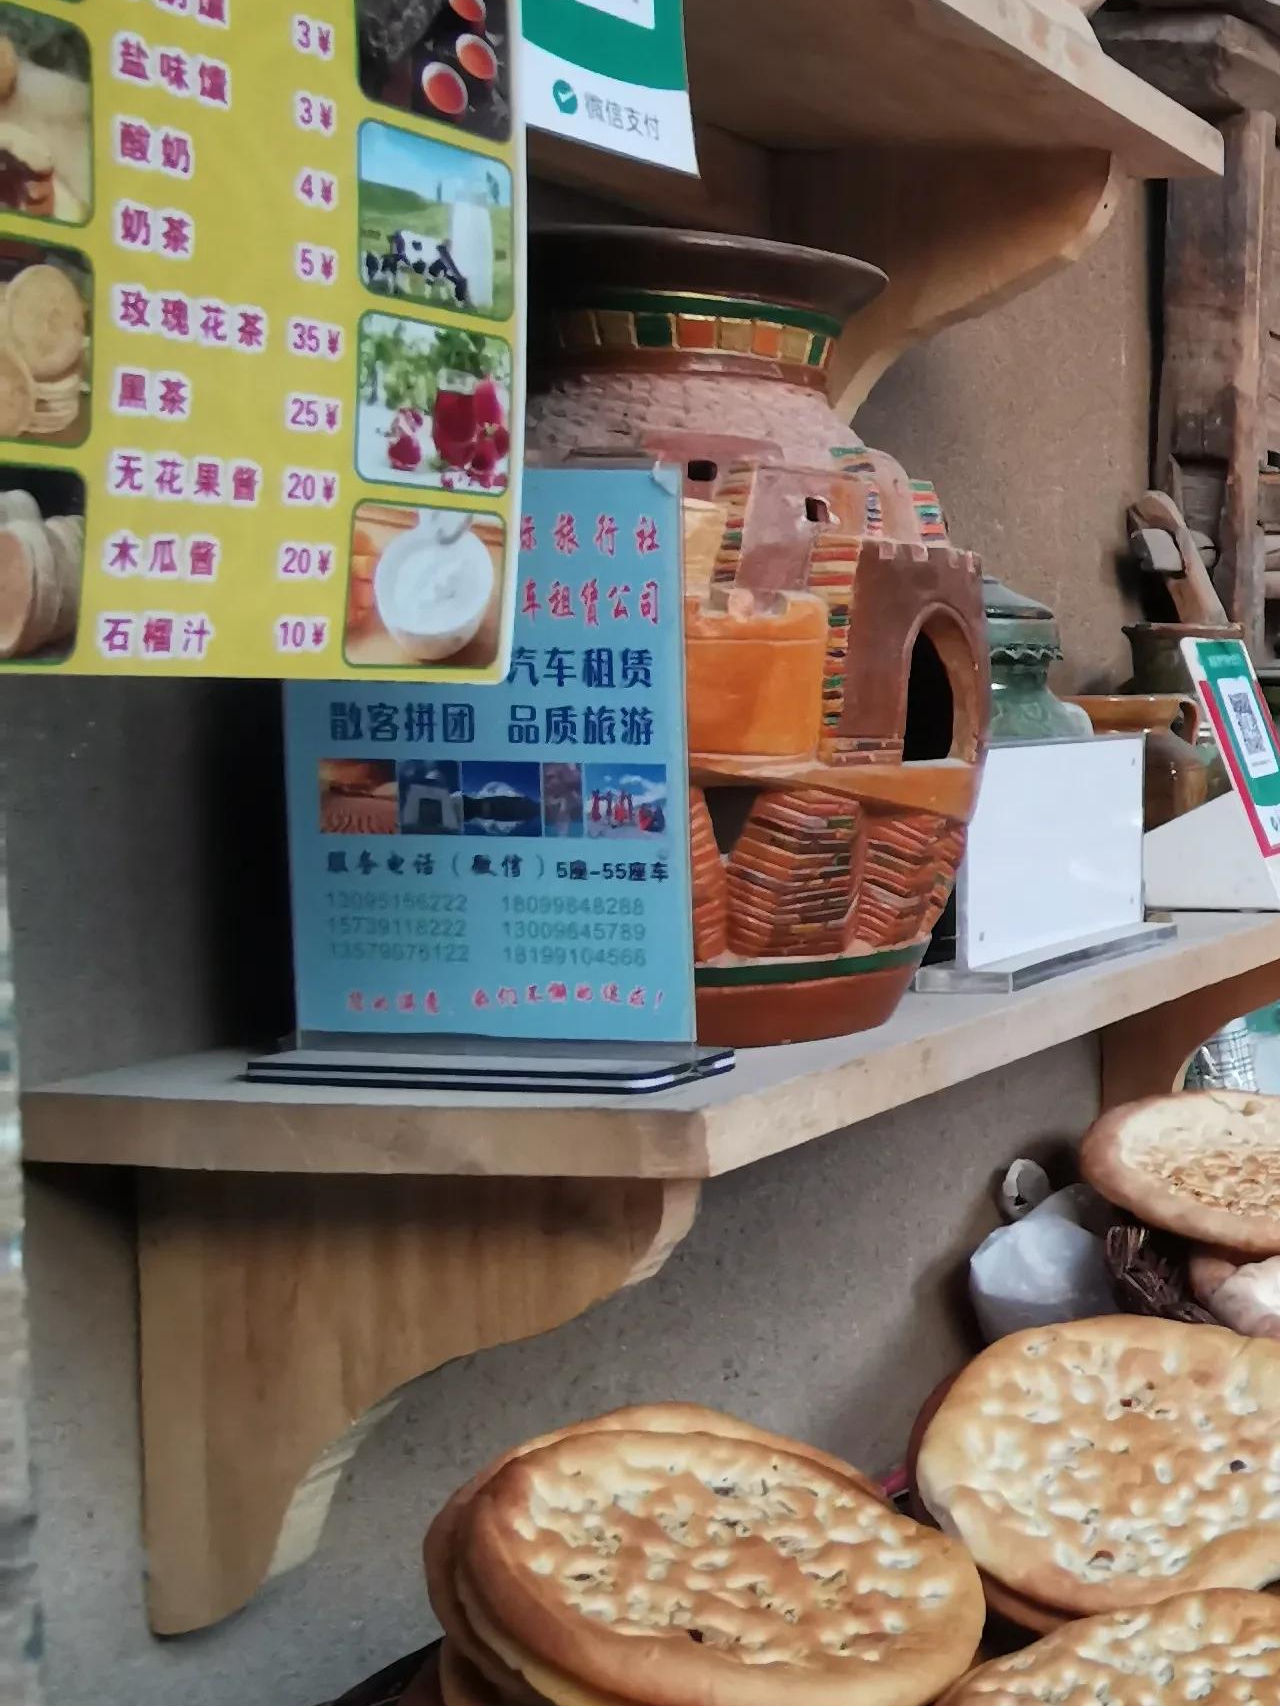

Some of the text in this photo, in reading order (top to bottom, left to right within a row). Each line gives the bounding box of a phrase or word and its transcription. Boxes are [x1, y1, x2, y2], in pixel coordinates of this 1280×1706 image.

[584, 92, 660, 141] 微信支付
[120, 121, 191, 173] 酸奶
[121, 206, 191, 253] 奶茶
[119, 289, 263, 347] 玫瑰花茶
[118, 373, 187, 414] 黑茶
[114, 455, 258, 501] 无花果酱
[109, 538, 216, 575] 木瓜酱
[102, 618, 210, 653] 石榴汁
[507, 646, 653, 689] 汽车租赁
[329, 701, 654, 746] 散客拼团 品质旅游
